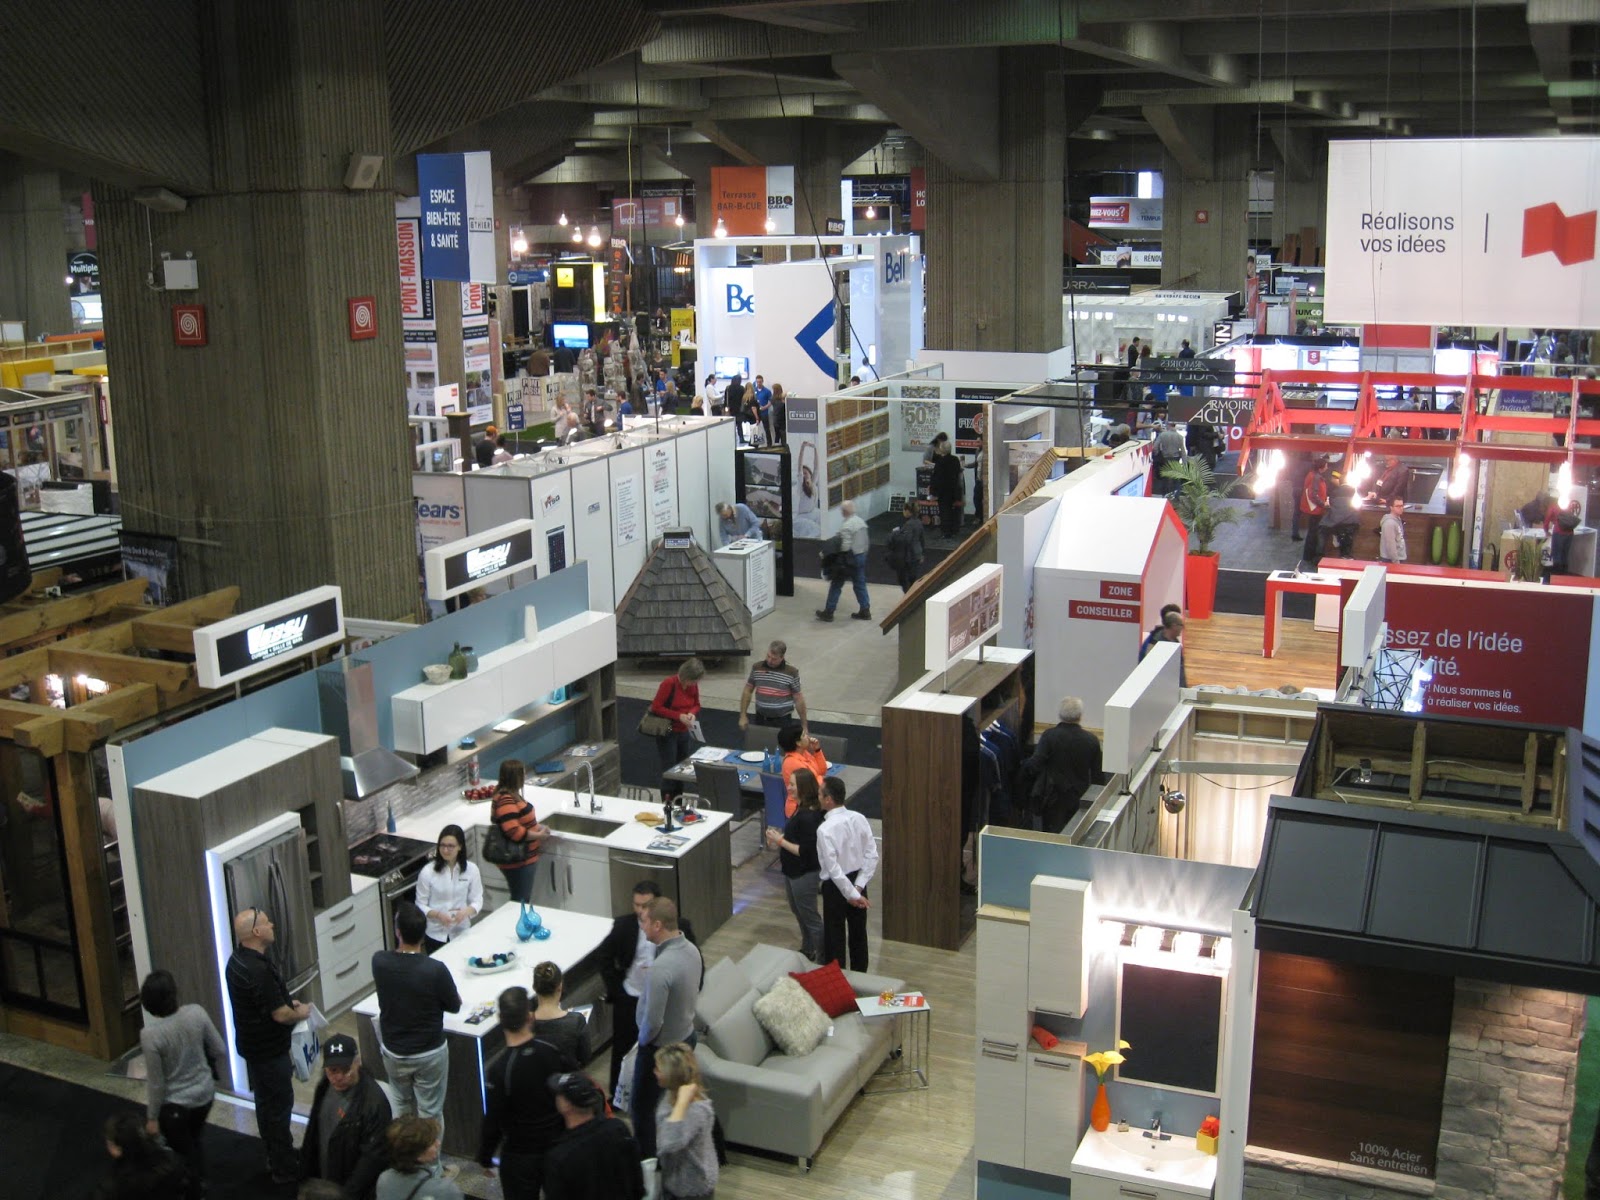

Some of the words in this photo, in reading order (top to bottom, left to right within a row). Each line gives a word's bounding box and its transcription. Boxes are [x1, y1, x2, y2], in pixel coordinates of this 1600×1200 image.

[430, 189, 455, 203] ESPACE
[722, 190, 756, 198] Terrasse
[768, 196, 793, 205] BBQ
[426, 208, 461, 226] BIEN-ÊTRE
[1361, 211, 1455, 230] Réalisons
[431, 233, 436, 247] &
[437, 231, 459, 248] SANTÉ
[1360, 239, 1392, 253] vos
[1397, 234, 1446, 253] idées
[885, 253, 906, 283] Bell
[469, 284, 481, 309] PON
[726, 283, 754, 313] Be
[1199, 399, 1254, 410] ARMOIRE
[905, 406, 927, 424] 50
[1188, 408, 1241, 424] AGLY
[418, 503, 460, 519] ears
[1108, 586, 1133, 596] ZONE
[1076, 605, 1133, 618] CONSEILLER
[1386, 628, 1430, 646] ssez
[1436, 629, 1461, 648] de
[1467, 630, 1523, 653] l'idée
[1433, 684, 1457, 695] Nous
[1460, 687, 1500, 698] sommes
[1503, 689, 1512, 699] là
[1436, 698, 1471, 709] réaliser
[1473, 701, 1491, 710] vos
[1493, 701, 1521, 713] idées.
[1359, 1142, 1390, 1157] 100%
[1392, 1148, 1421, 1163] Acier
[1350, 1151, 1375, 1165] Sans
[1378, 1158, 1428, 1175] entretien
